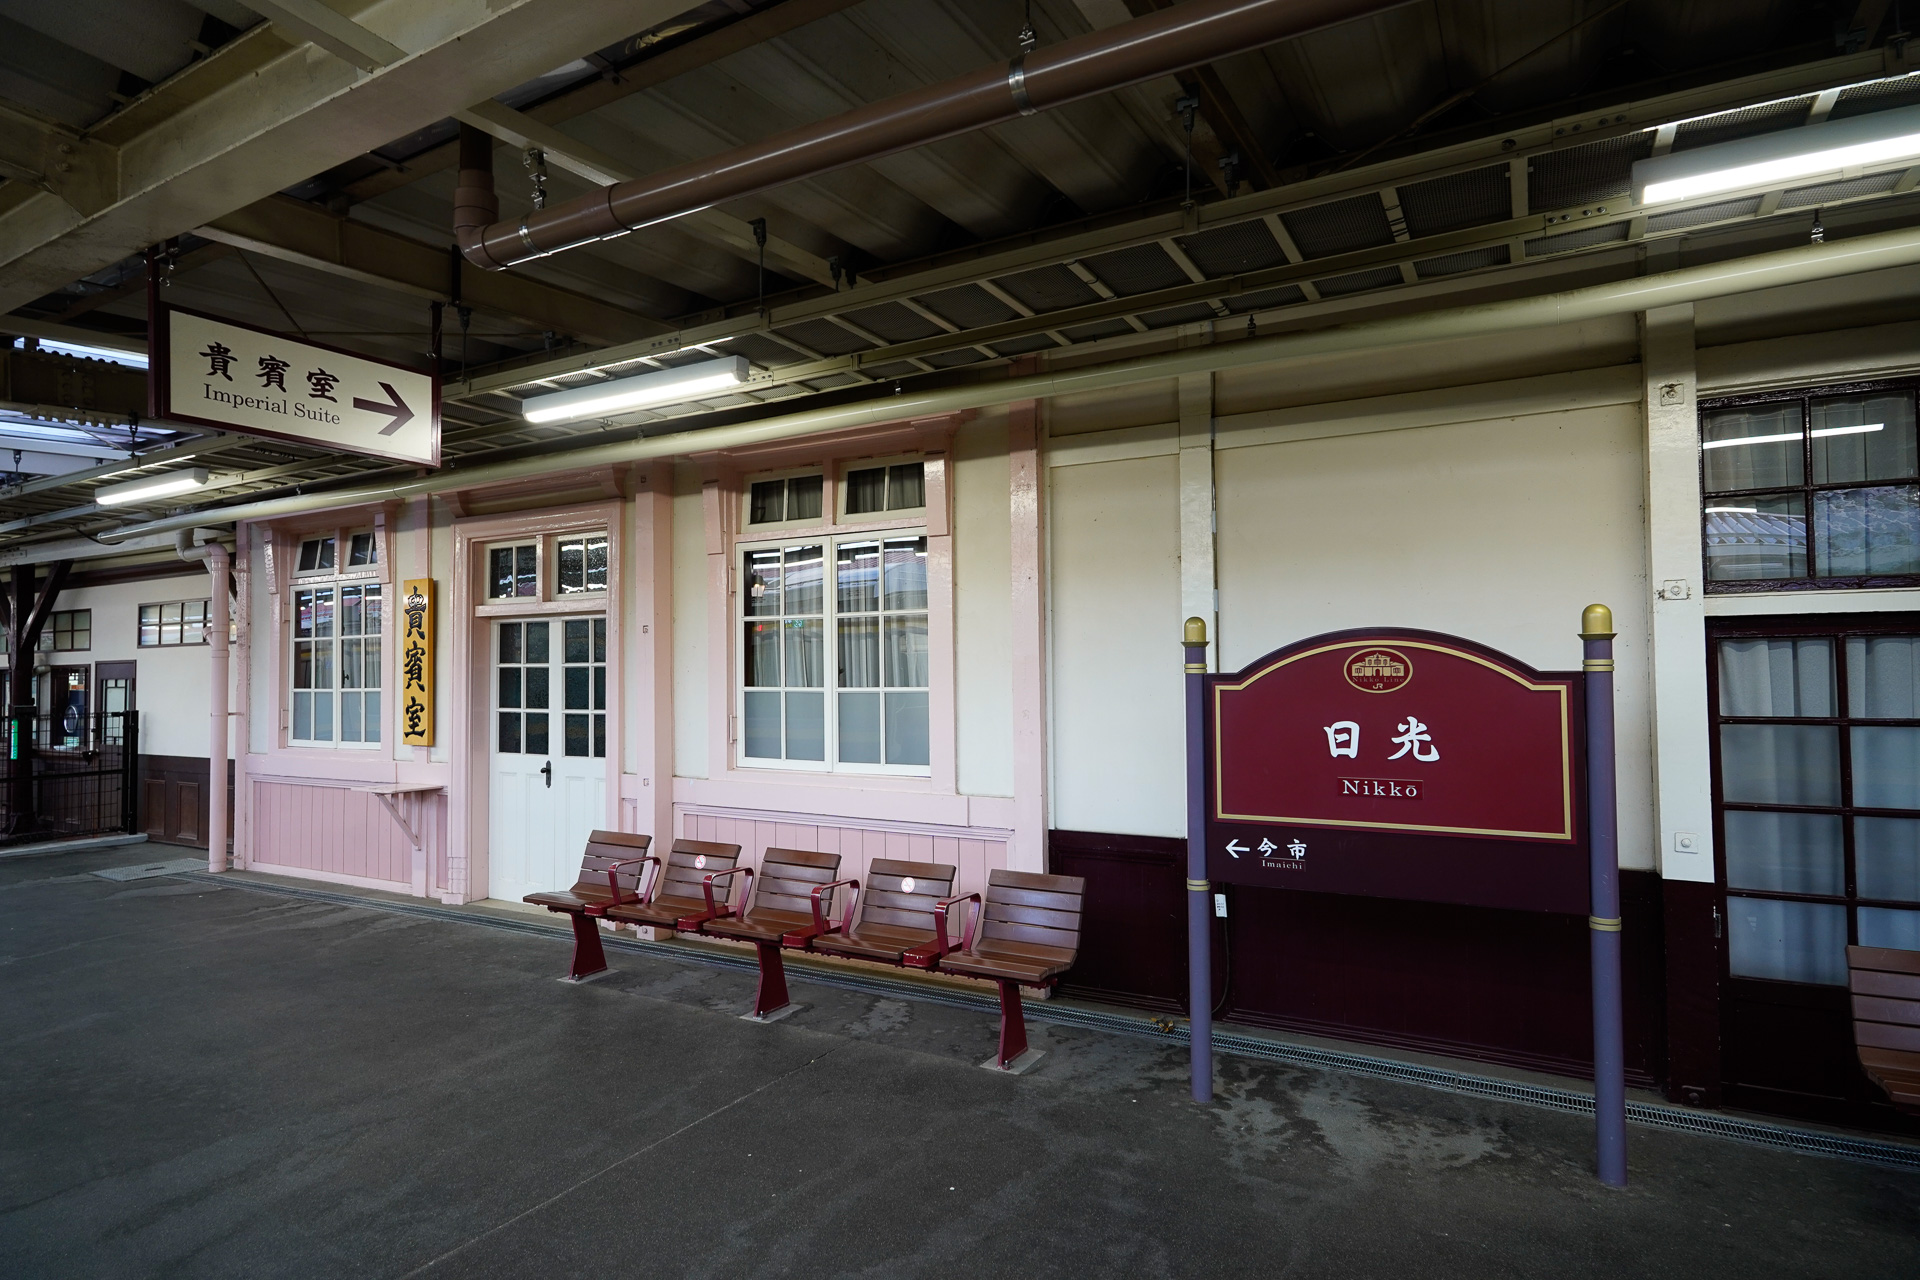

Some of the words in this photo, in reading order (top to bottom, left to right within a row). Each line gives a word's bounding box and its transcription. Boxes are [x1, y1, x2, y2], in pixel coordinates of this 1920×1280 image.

[199, 341, 340, 403] 貴賓室
[204, 383, 287, 414] Imperial
[294, 402, 340, 425] Suite
[404, 585, 426, 738] 貴賓室
[1323, 716, 1440, 762] 日光
[1342, 780, 1418, 797] Nikkō
[1257, 837, 1307, 860] 今市
[1262, 859, 1303, 870] Imaichi
